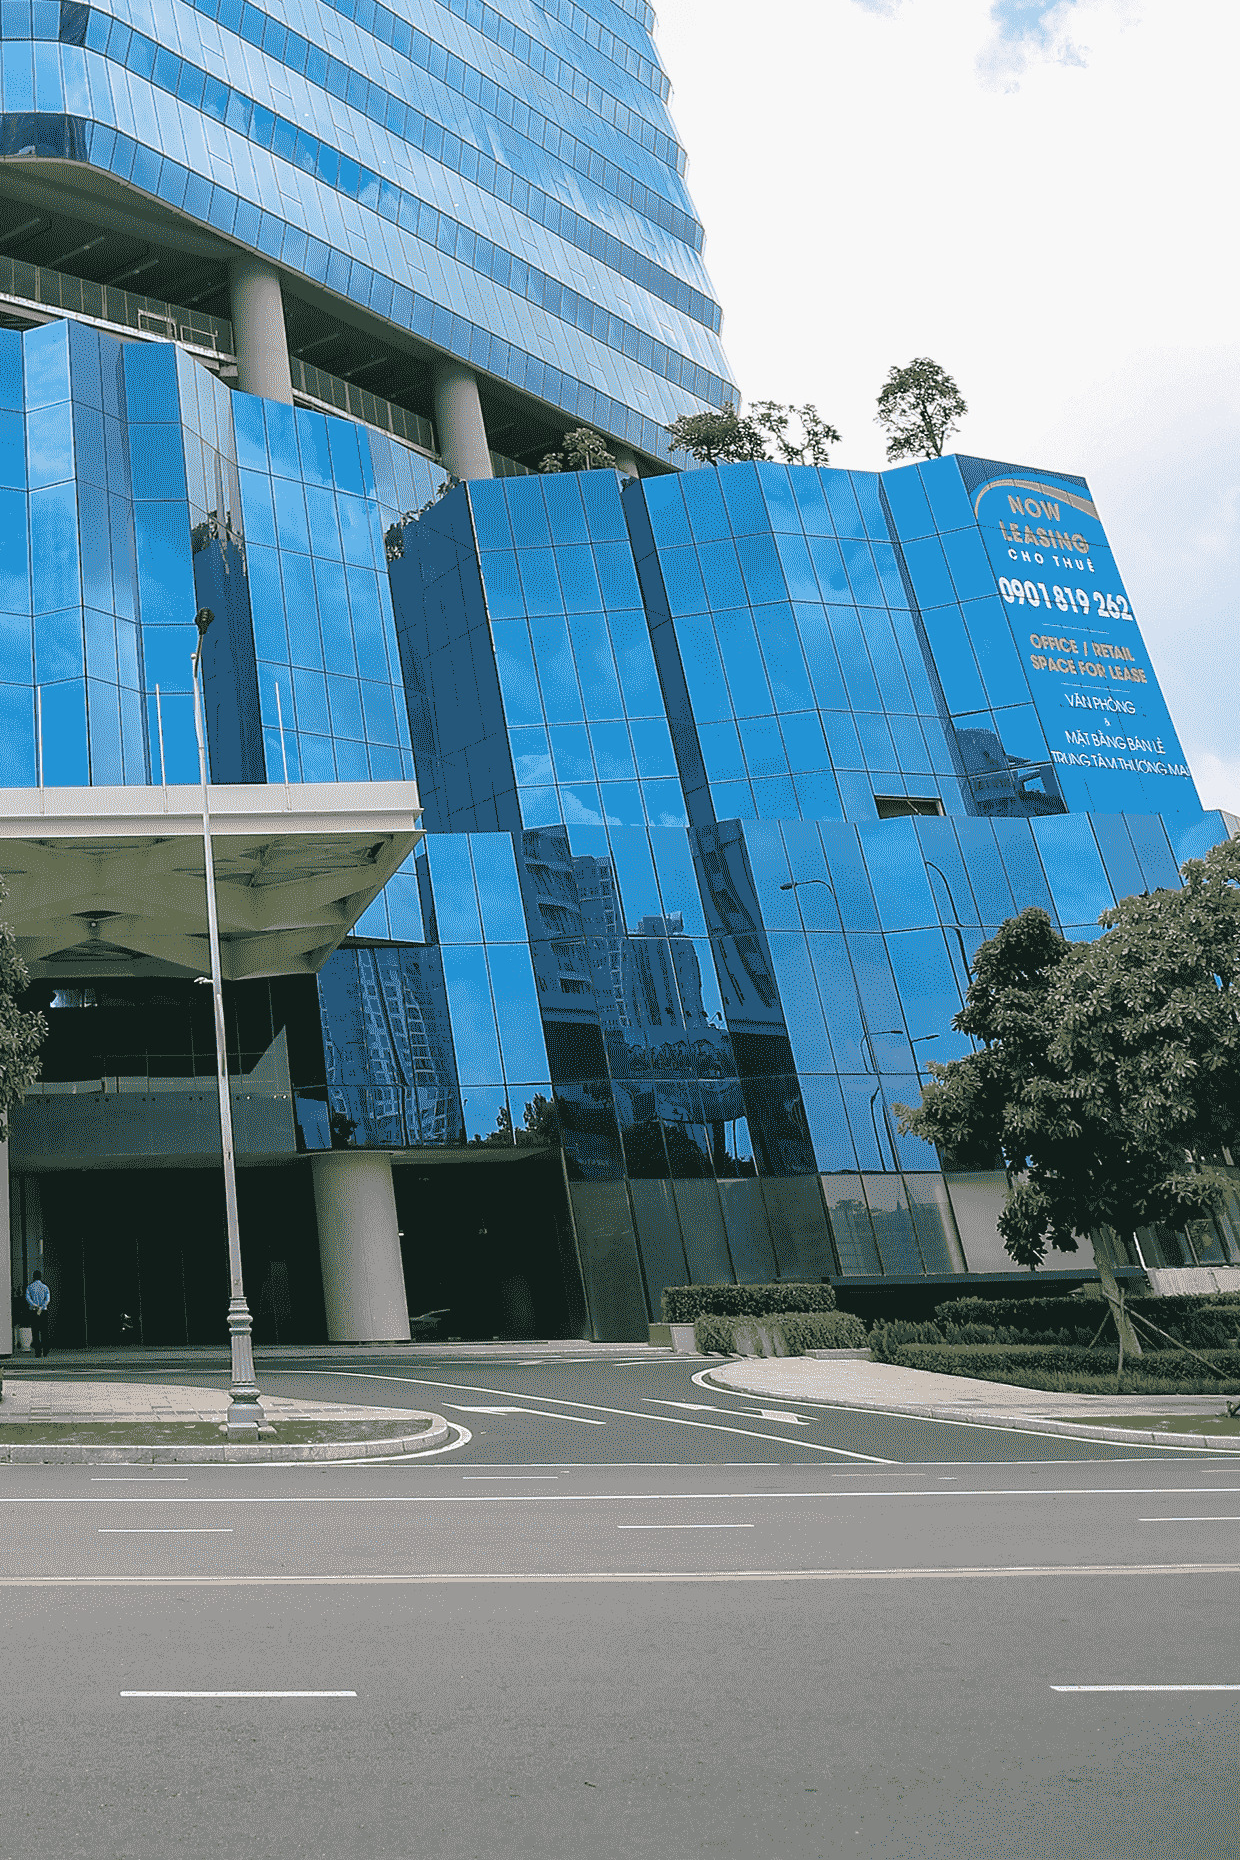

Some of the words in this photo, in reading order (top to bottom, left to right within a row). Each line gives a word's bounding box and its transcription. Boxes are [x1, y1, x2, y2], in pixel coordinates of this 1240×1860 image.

[1007, 494, 1061, 522] NOW
[999, 519, 1090, 554] LEASING
[1007, 548, 1045, 564] CHO
[1092, 590, 1134, 621] 262
[1029, 633, 1079, 654] OFFICE
[1091, 642, 1135, 662] RETAIL
[1030, 654, 1078, 675] SPACE
[1078, 660, 1107, 679] FOR
[1108, 665, 1148, 683] LEASE
[1050, 750, 1091, 767] TRUNG
